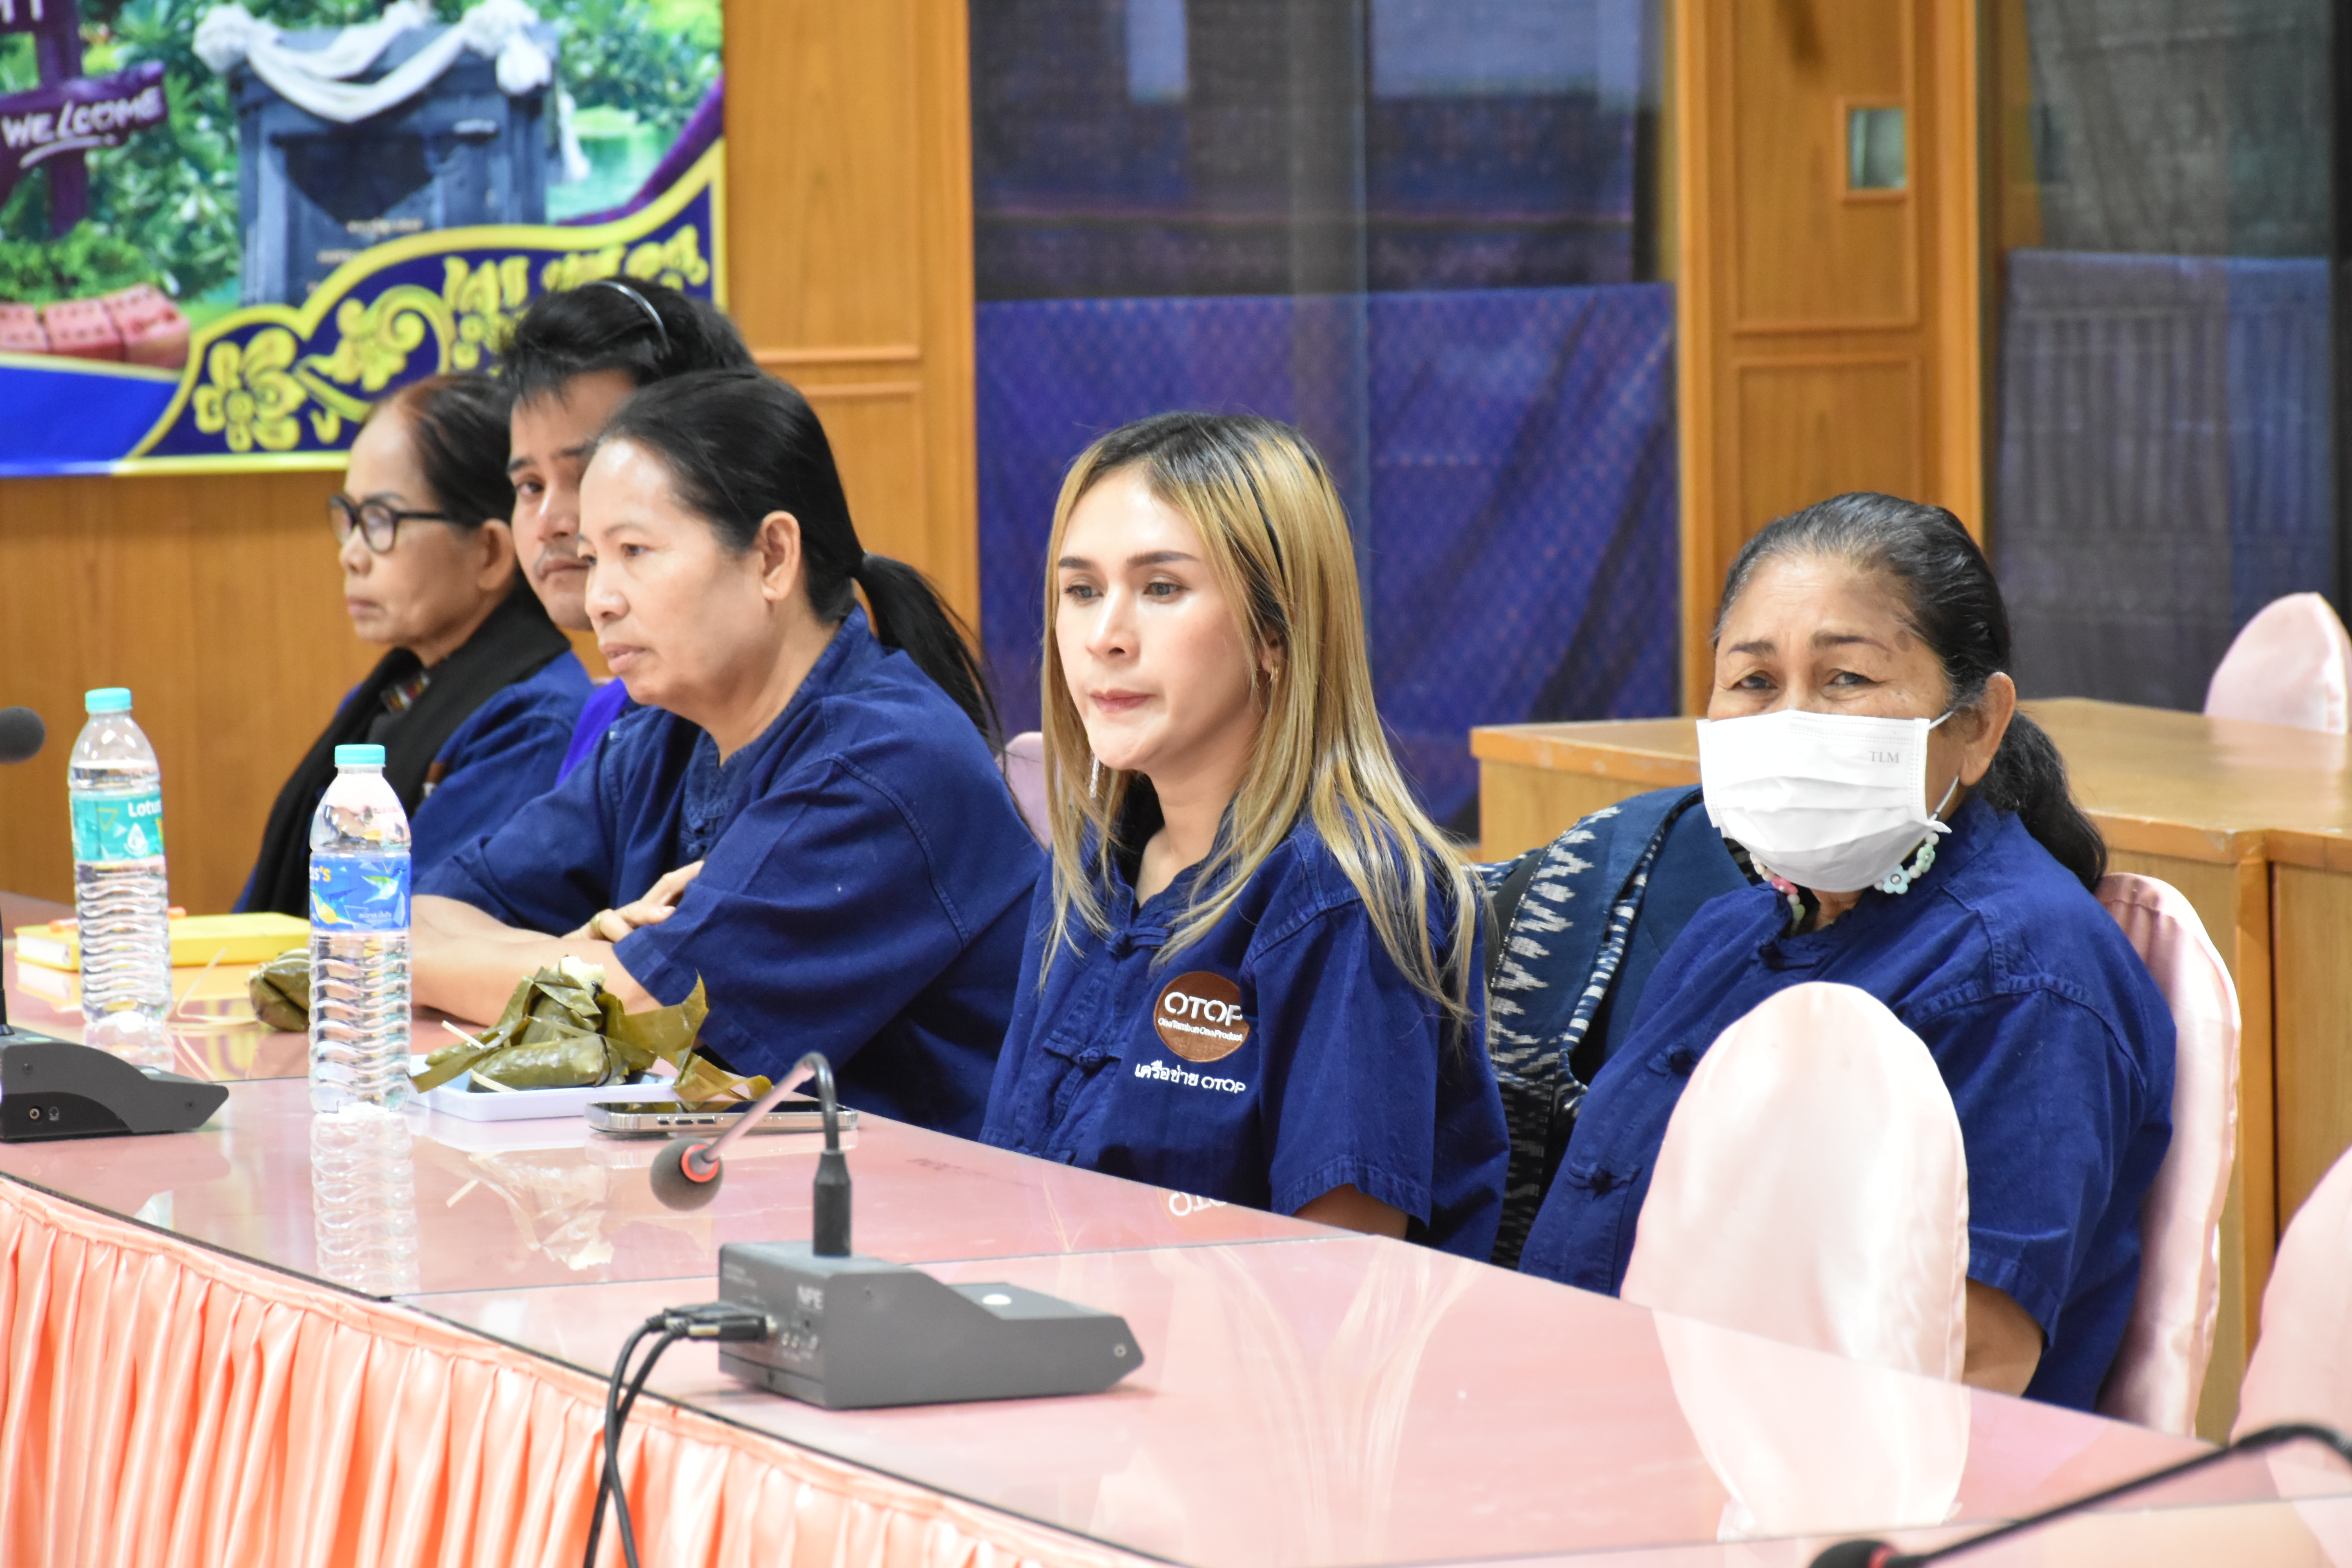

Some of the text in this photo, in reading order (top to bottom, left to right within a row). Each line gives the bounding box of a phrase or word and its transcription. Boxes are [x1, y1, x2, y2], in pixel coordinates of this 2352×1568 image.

[1869, 751, 1899, 763] TLM
[1165, 992, 1243, 1026] OTOP
[1158, 1017, 1172, 1027] One
[1214, 1029, 1243, 1042] Product
[1135, 1060, 1246, 1093] เครือข่าย OTOP
